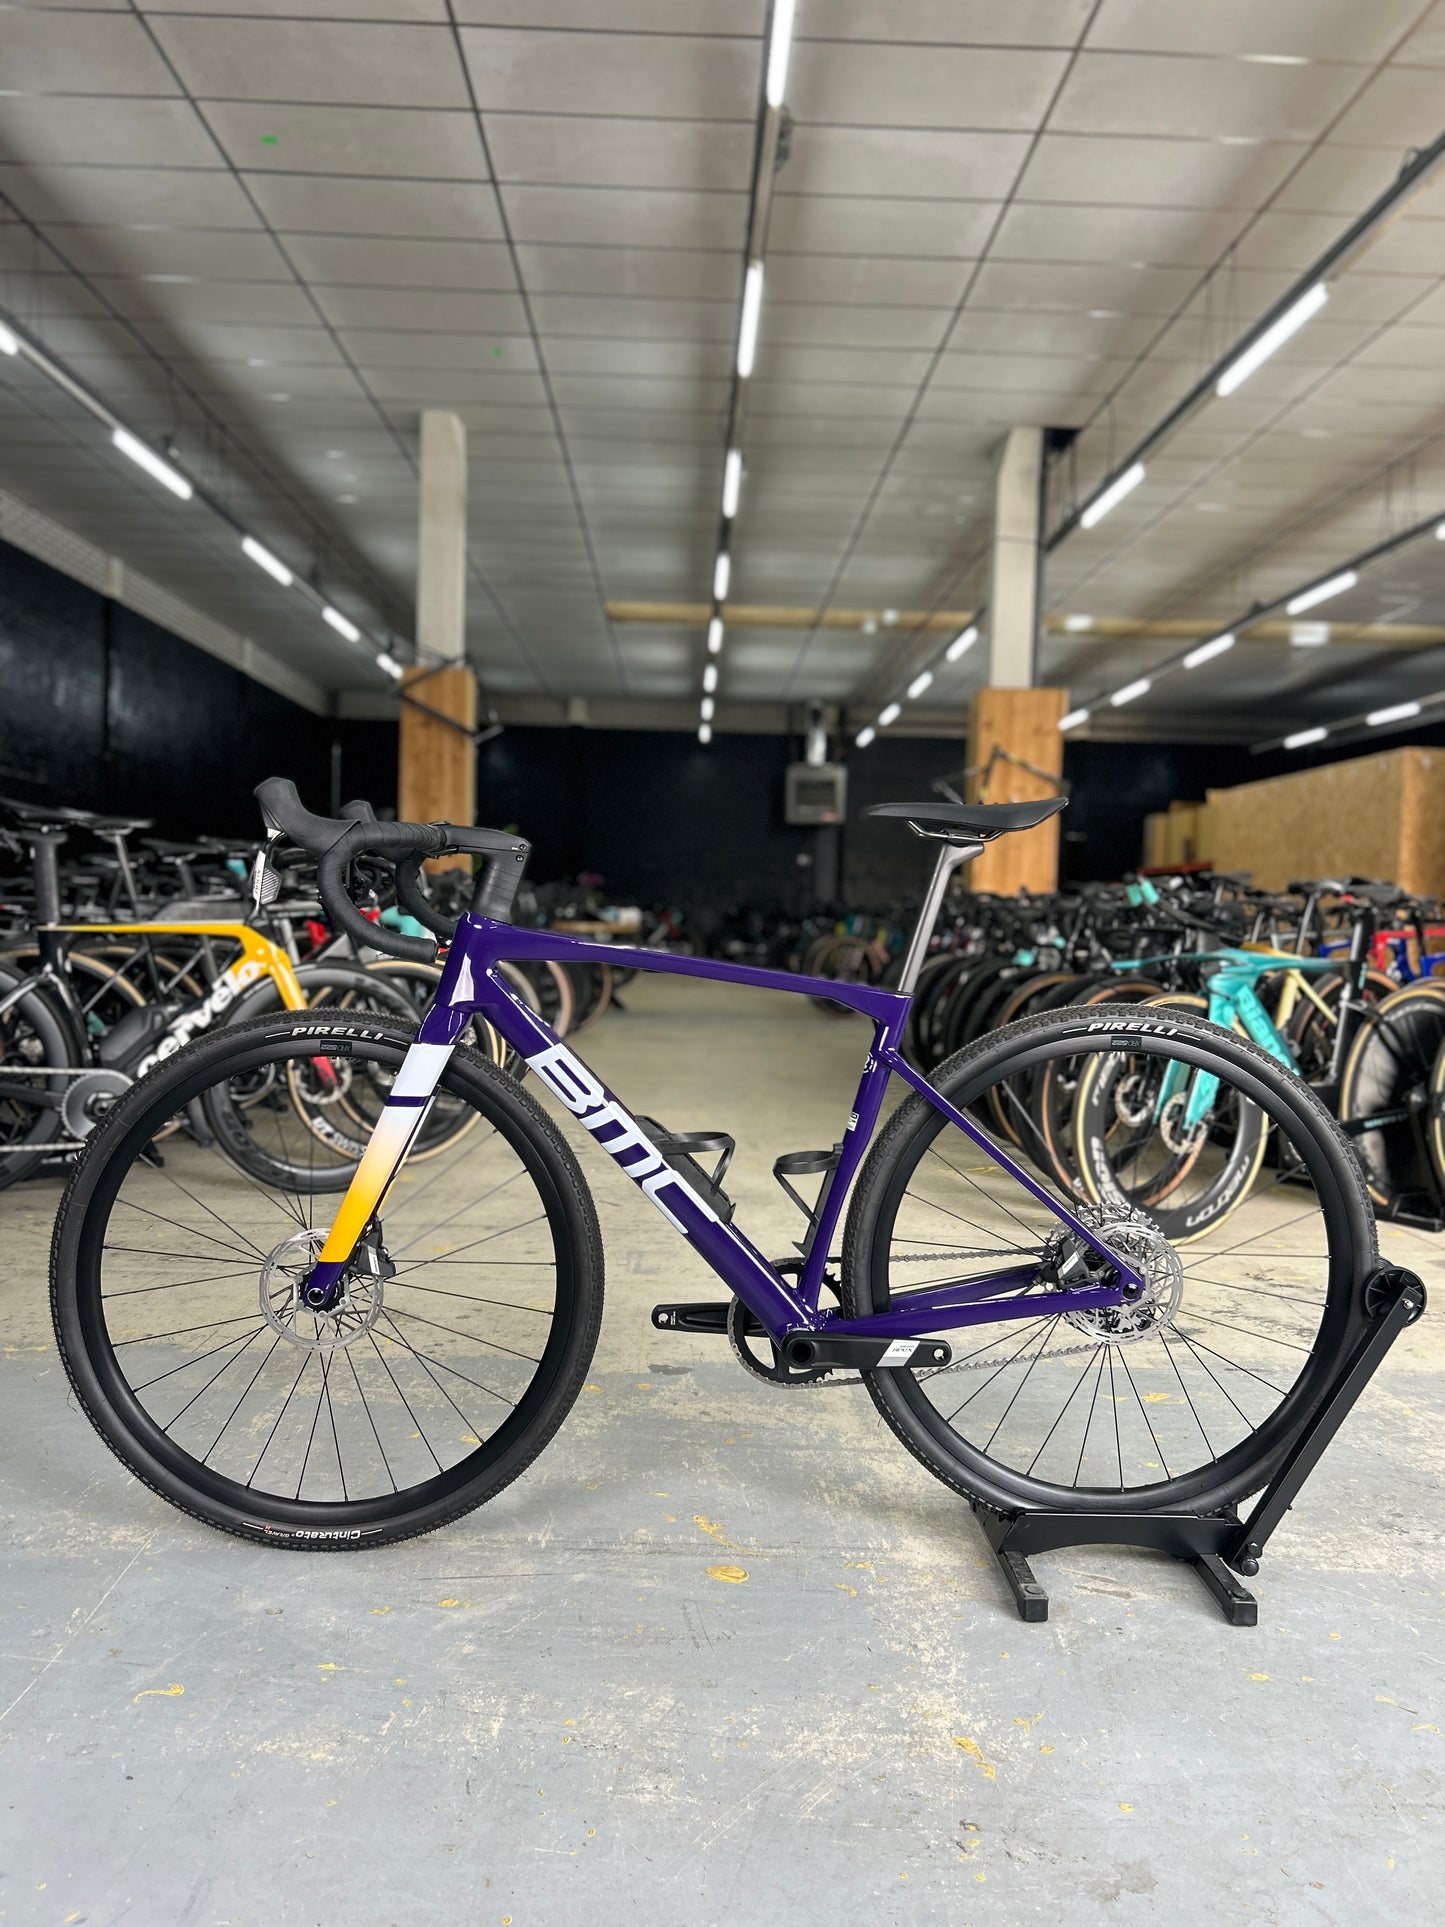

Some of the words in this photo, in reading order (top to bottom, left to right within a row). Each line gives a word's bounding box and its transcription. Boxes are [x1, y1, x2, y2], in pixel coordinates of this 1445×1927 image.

[291, 1026, 384, 1041] PIRELLI
[1087, 1022, 1178, 1036] PIRELLI
[525, 1043, 719, 1234] BMC
